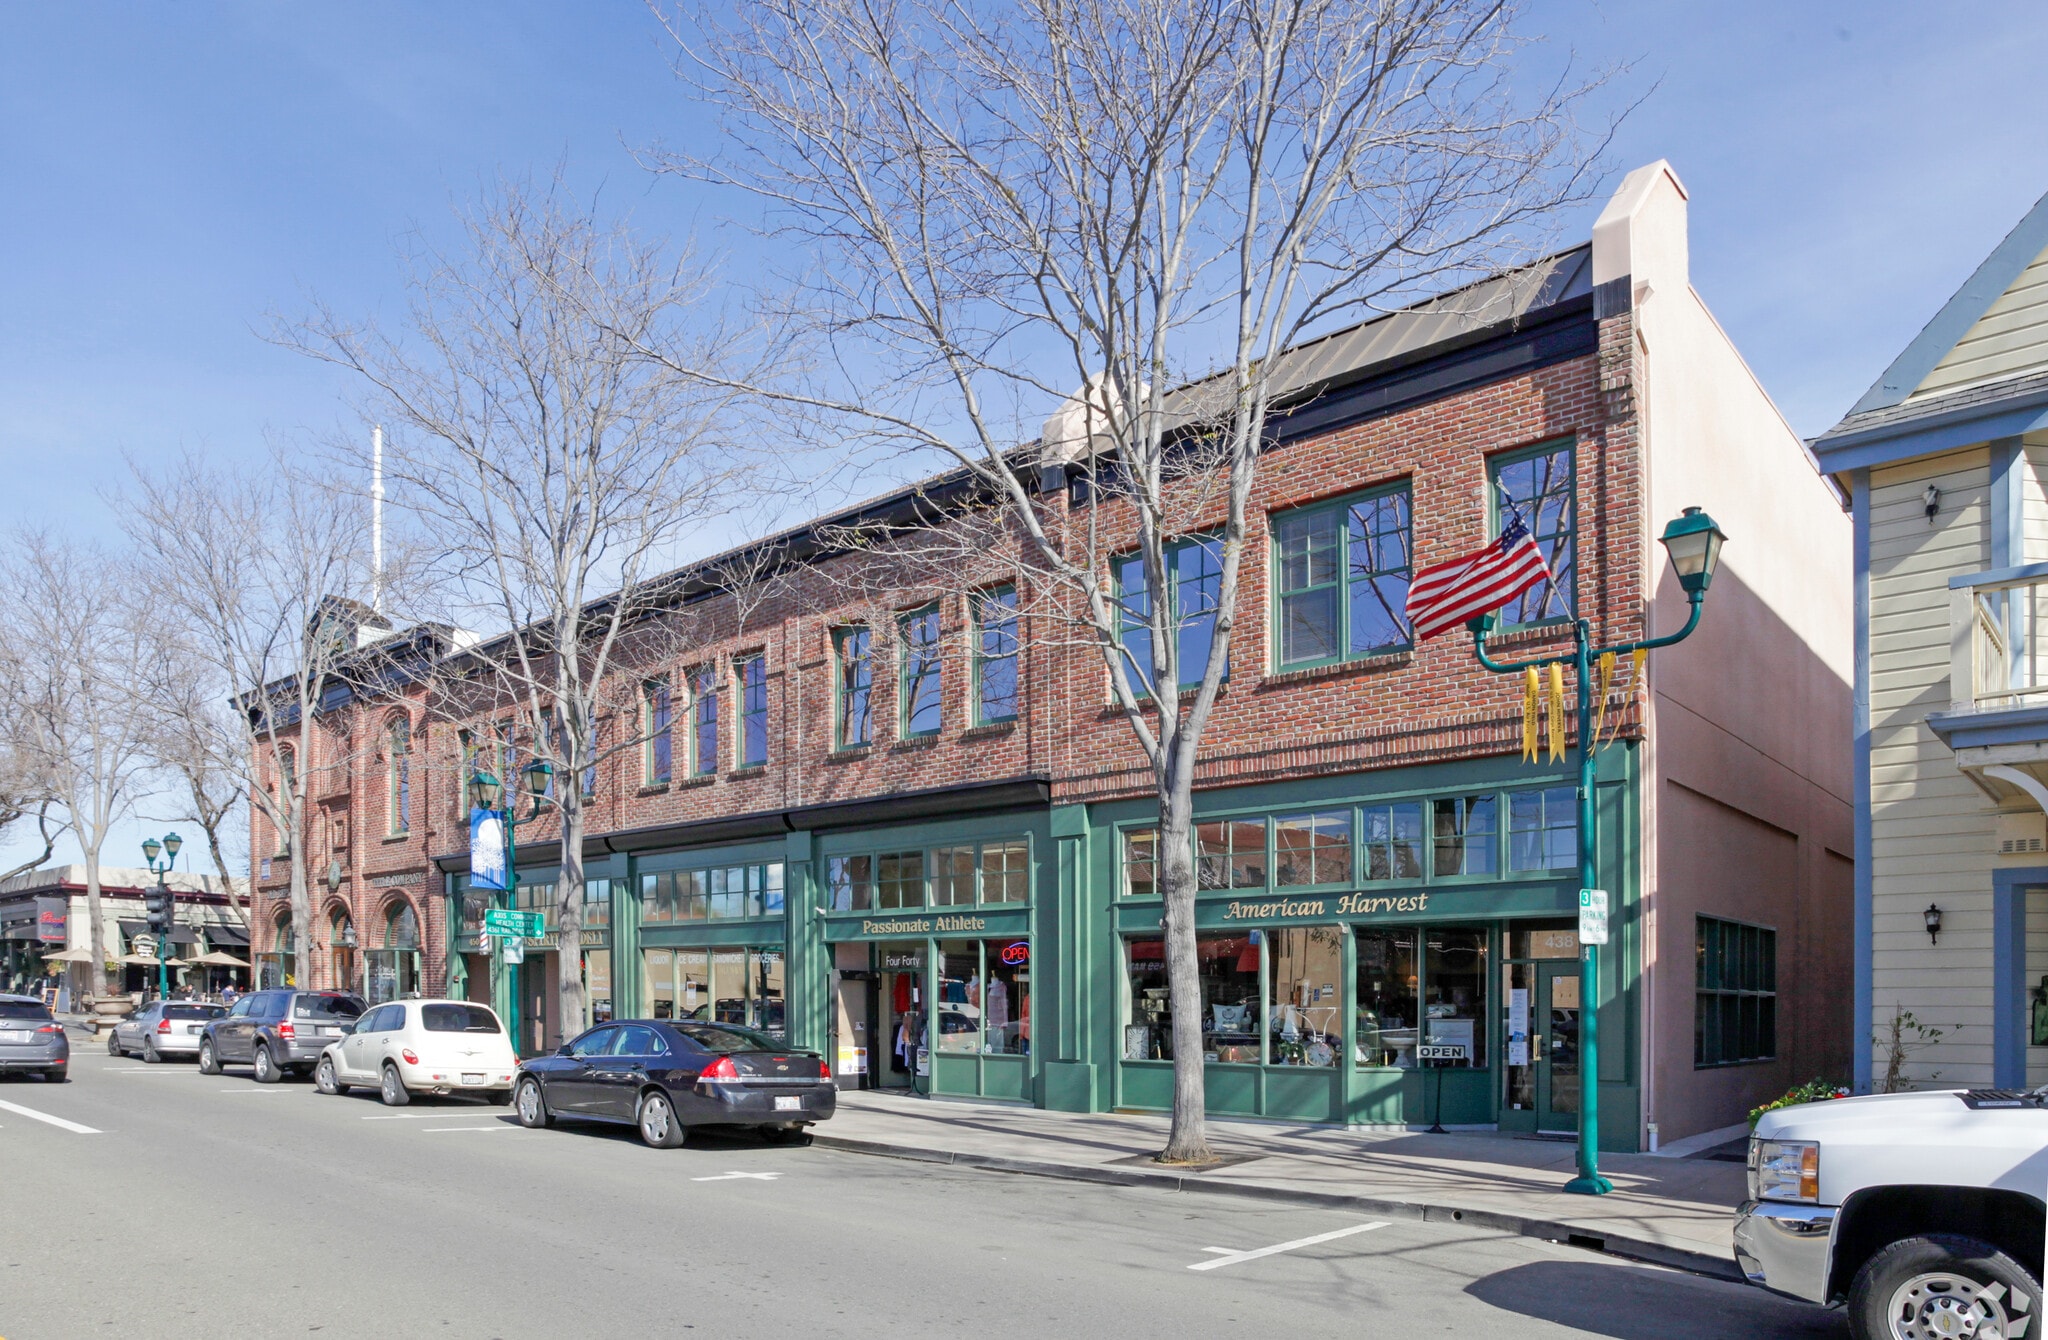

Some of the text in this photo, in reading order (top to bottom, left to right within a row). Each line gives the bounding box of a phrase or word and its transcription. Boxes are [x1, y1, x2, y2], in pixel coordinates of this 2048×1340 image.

[1582, 892, 1589, 904] 3
[1222, 892, 1428, 919] American Harvest
[1581, 910, 1606, 920] PARKING
[863, 916, 985, 934] Passionate Athlete
[580, 929, 604, 945] DELI
[1545, 936, 1574, 949] 438
[650, 954, 669, 964] LIQUOR
[750, 953, 780, 964] GROCERIES
[1002, 947, 1030, 960] OPEN
[885, 955, 920, 967] Four Forty
[1420, 1047, 1462, 1057] OPEN
